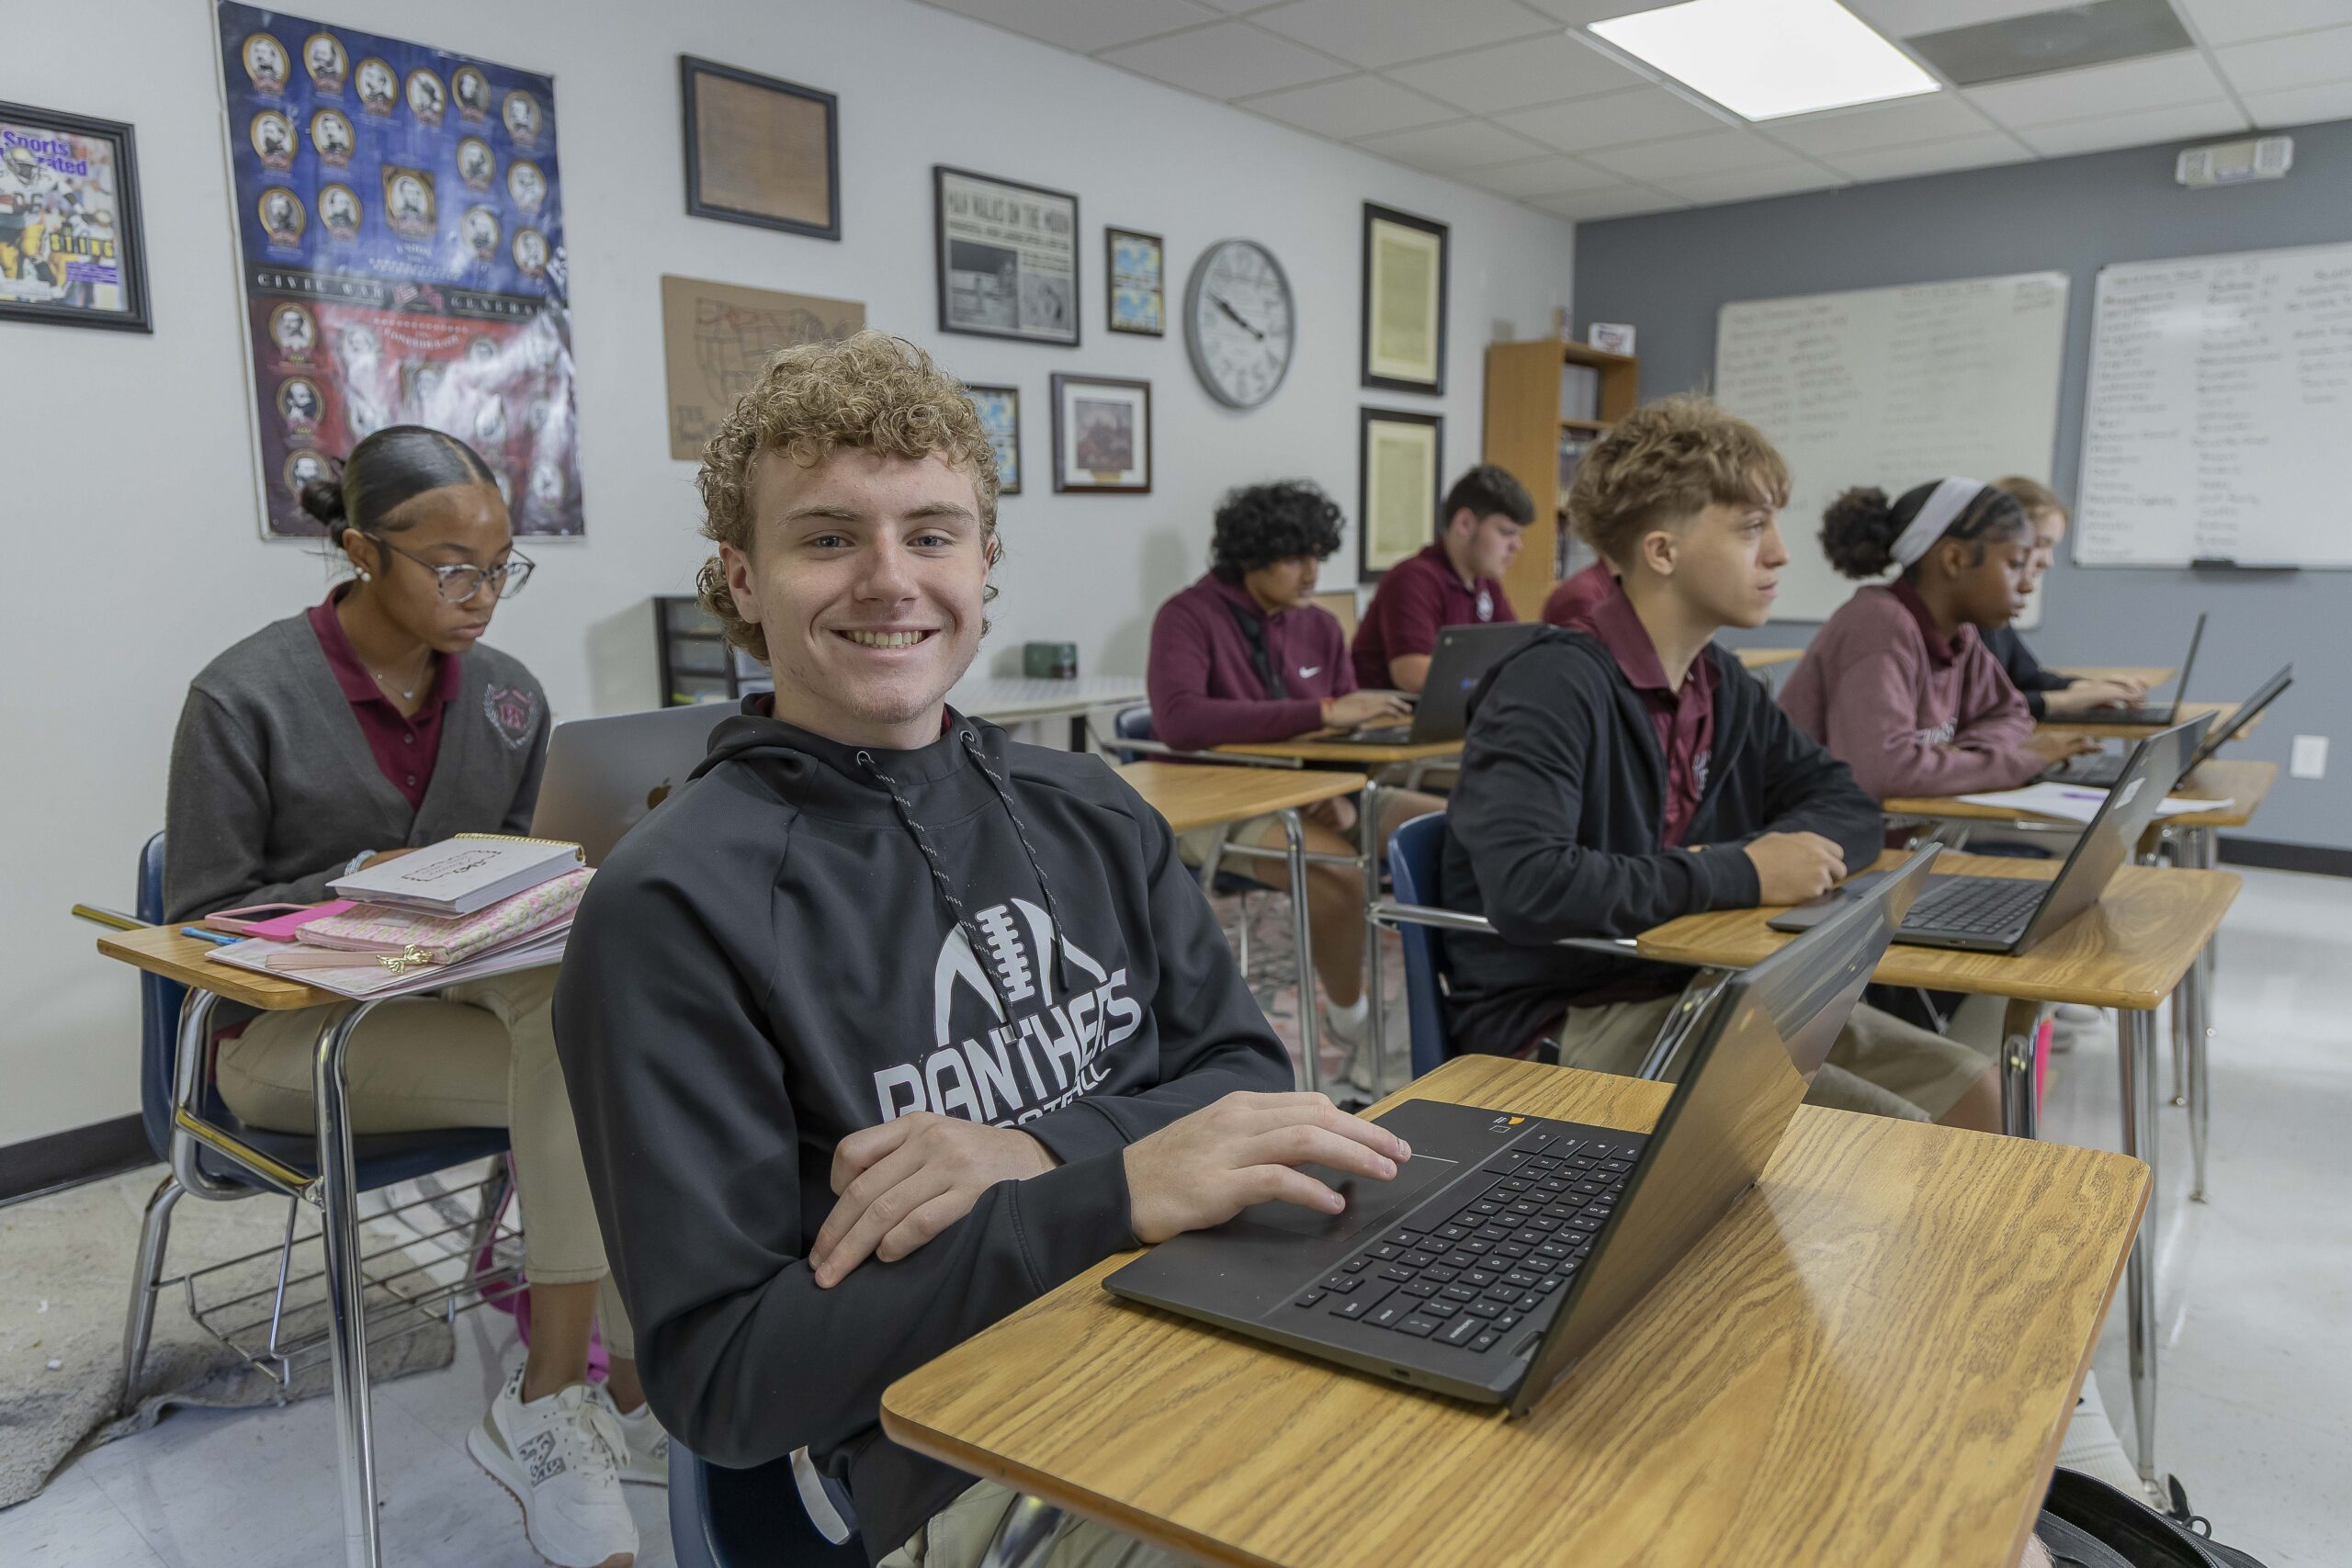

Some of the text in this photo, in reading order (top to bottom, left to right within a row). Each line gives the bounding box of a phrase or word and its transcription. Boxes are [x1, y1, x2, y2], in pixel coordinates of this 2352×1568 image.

[3, 130, 71, 157] Sports
[258, 273, 326, 294] CIVIL
[341, 282, 384, 299] WAR
